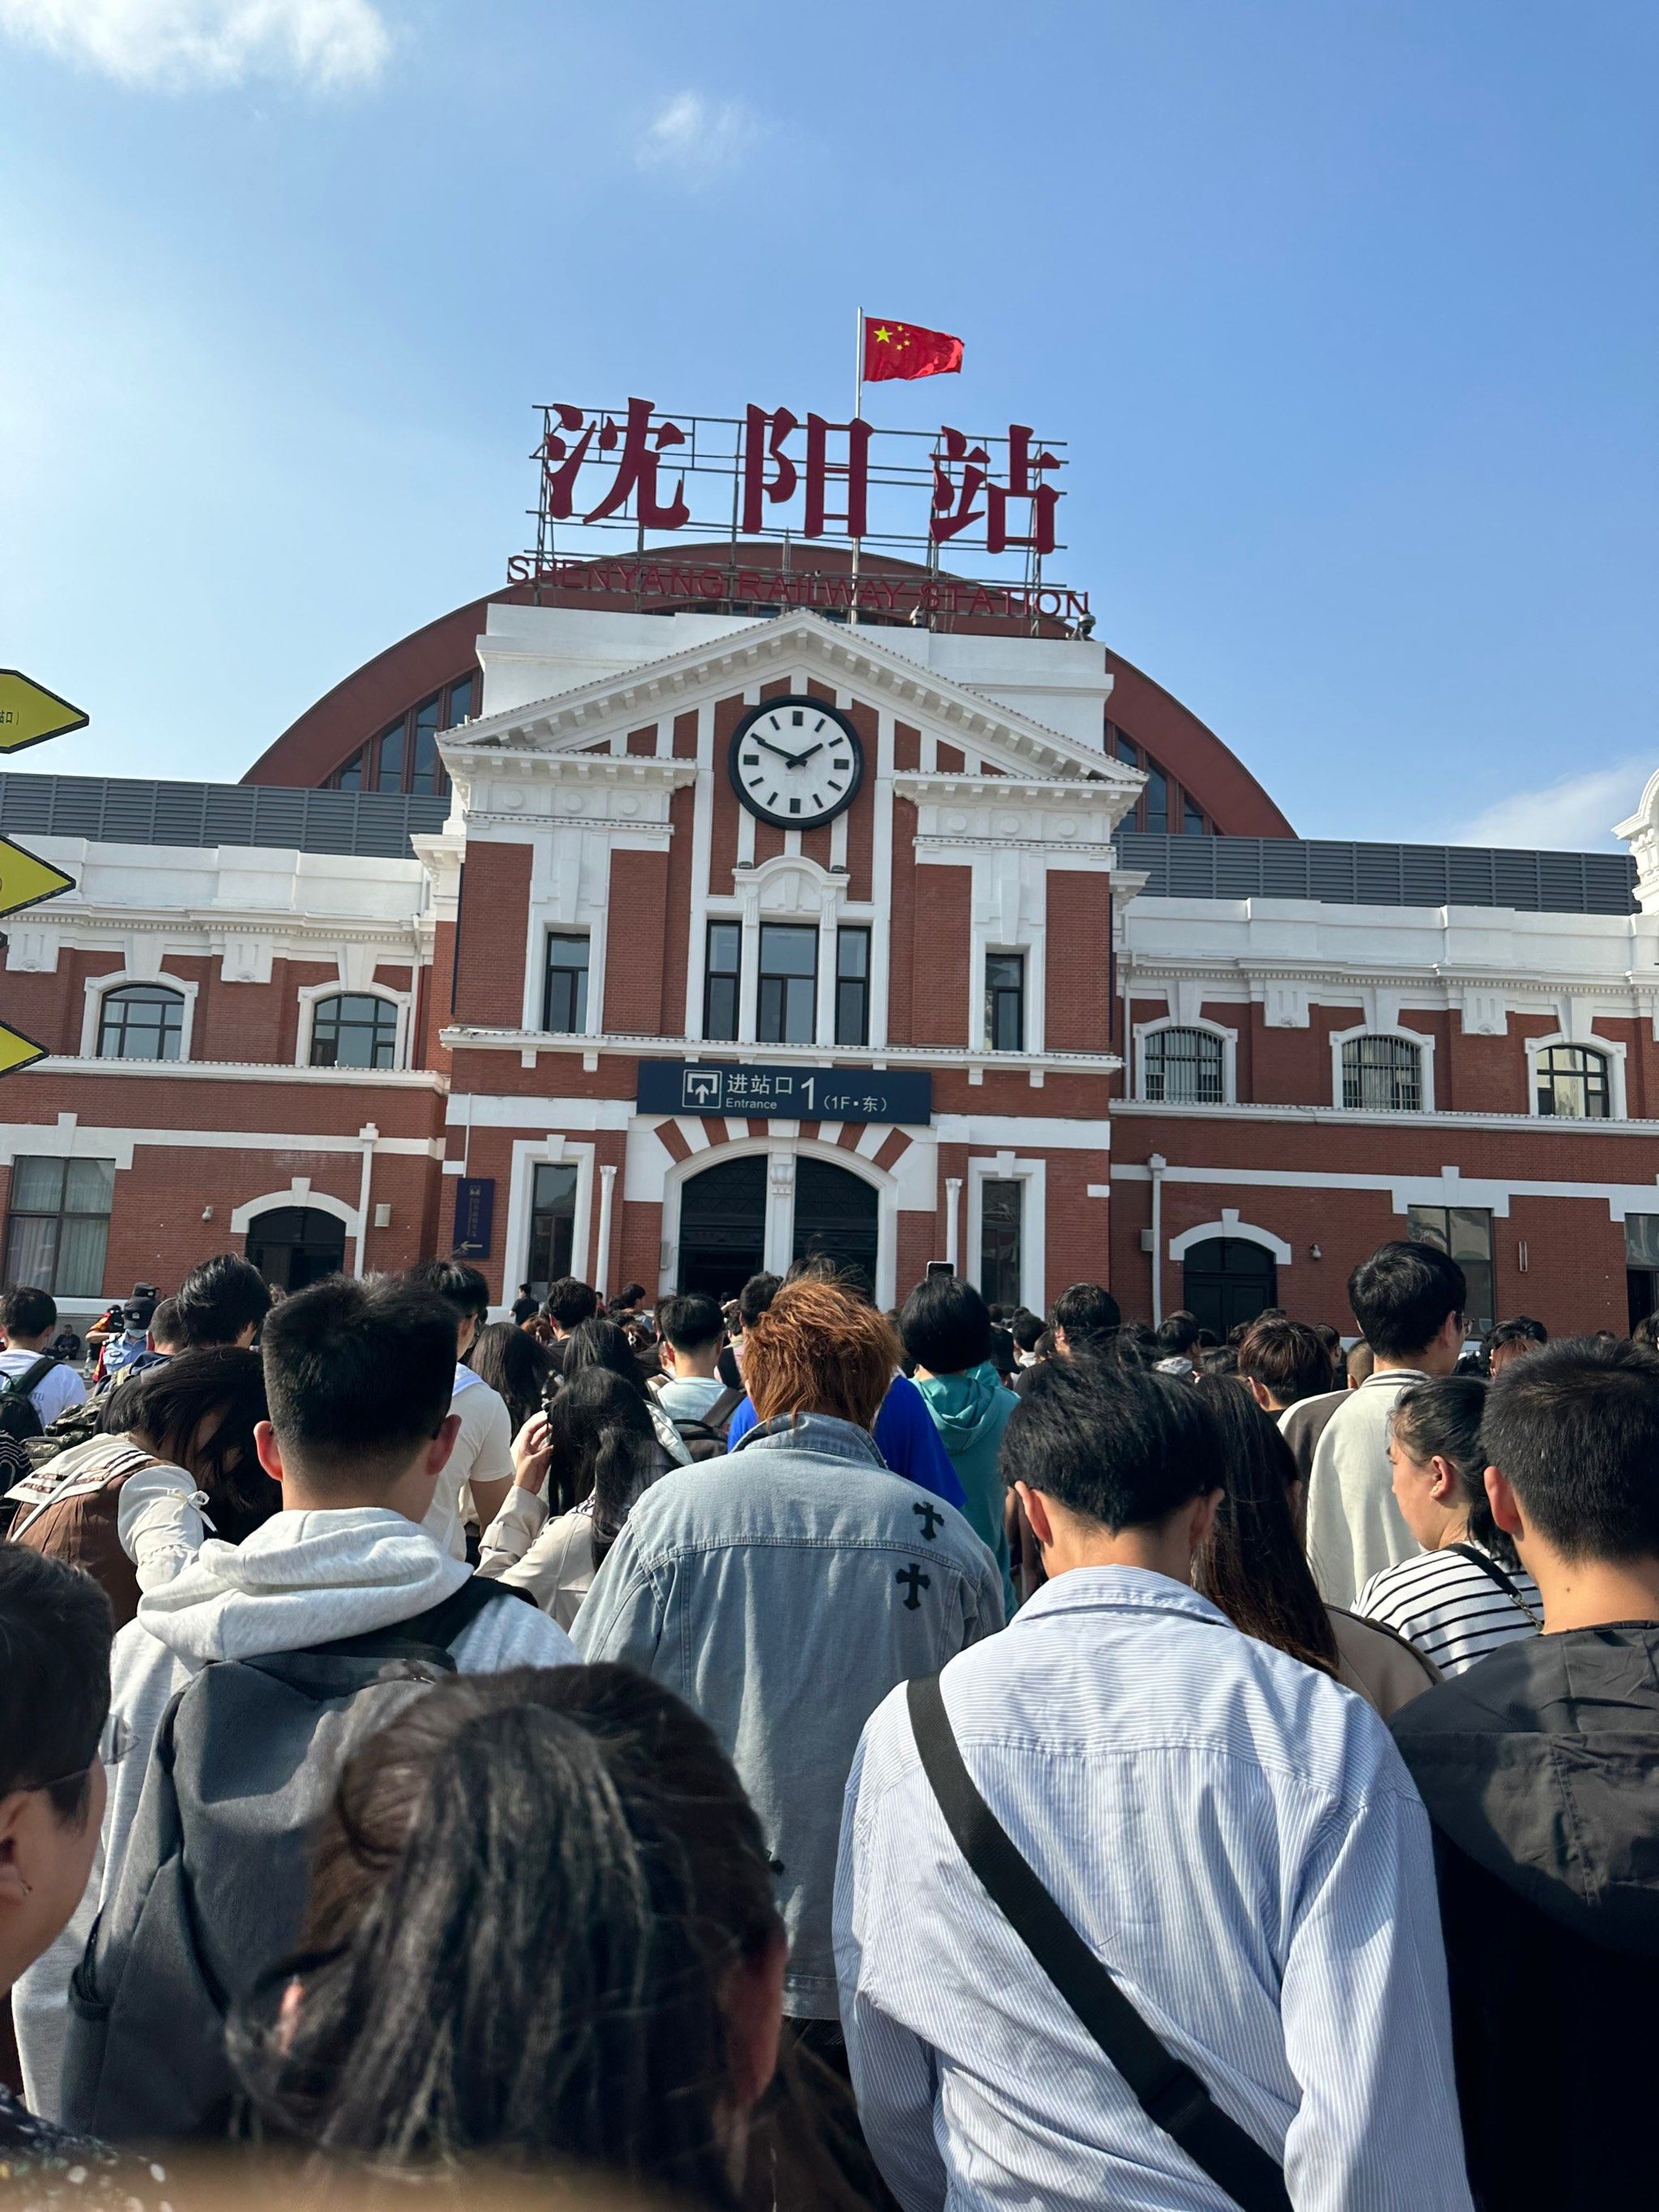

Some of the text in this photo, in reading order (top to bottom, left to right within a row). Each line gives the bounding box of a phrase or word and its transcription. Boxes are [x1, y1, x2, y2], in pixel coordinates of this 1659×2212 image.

[544, 397, 1061, 554] 沈阳站
[507, 555, 1088, 617] SHENYANG RAILWAY STATION
[726, 1097, 778, 1111] Entrance
[727, 1074, 792, 1095] 进站口
